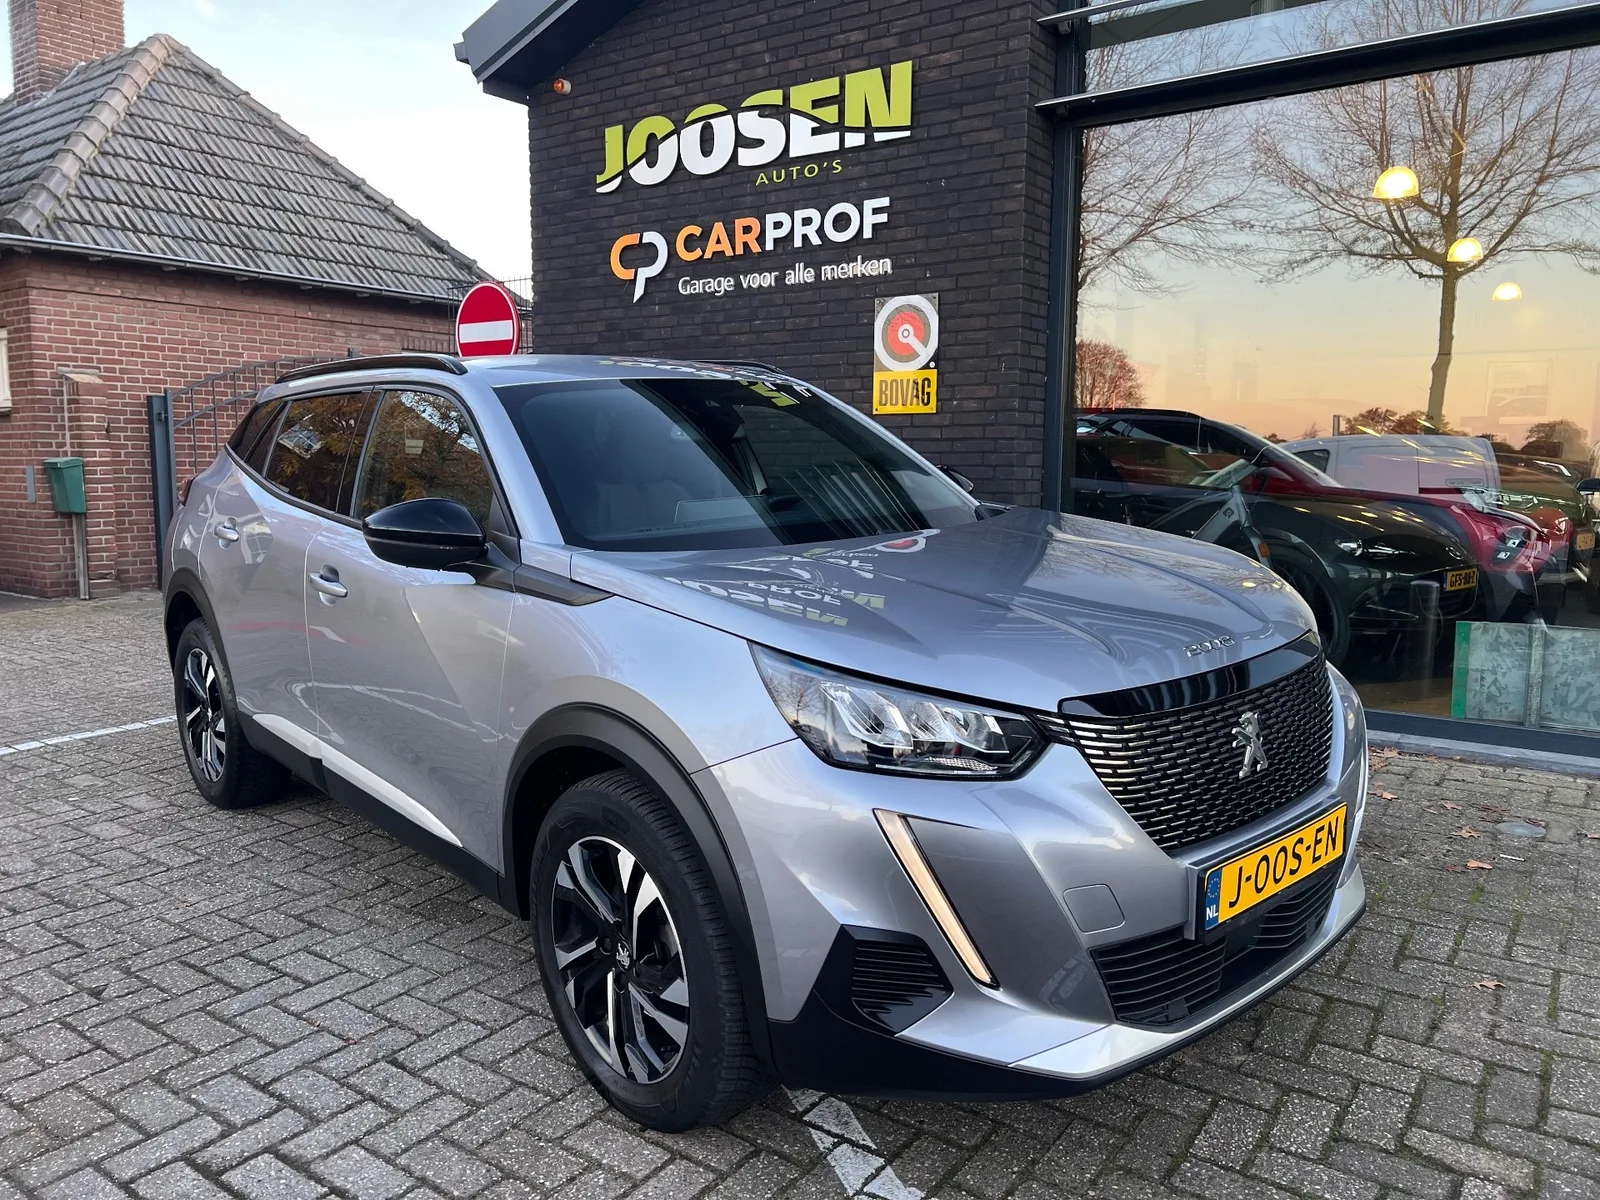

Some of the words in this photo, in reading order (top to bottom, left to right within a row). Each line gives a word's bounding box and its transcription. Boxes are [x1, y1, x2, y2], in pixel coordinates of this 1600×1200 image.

[596, 60, 913, 193] JOOSEN
[755, 159, 843, 186] AUTO'S
[675, 197, 890, 262] CARPROF
[678, 276, 735, 296] Garage
[740, 271, 779, 289] voor
[785, 262, 815, 285] alle
[821, 255, 893, 281] merken
[878, 377, 932, 408] BOVAG
[1183, 635, 1235, 657] 2008
[1228, 816, 1339, 908] J-OOS-EN
[1206, 907, 1219, 921] NL
